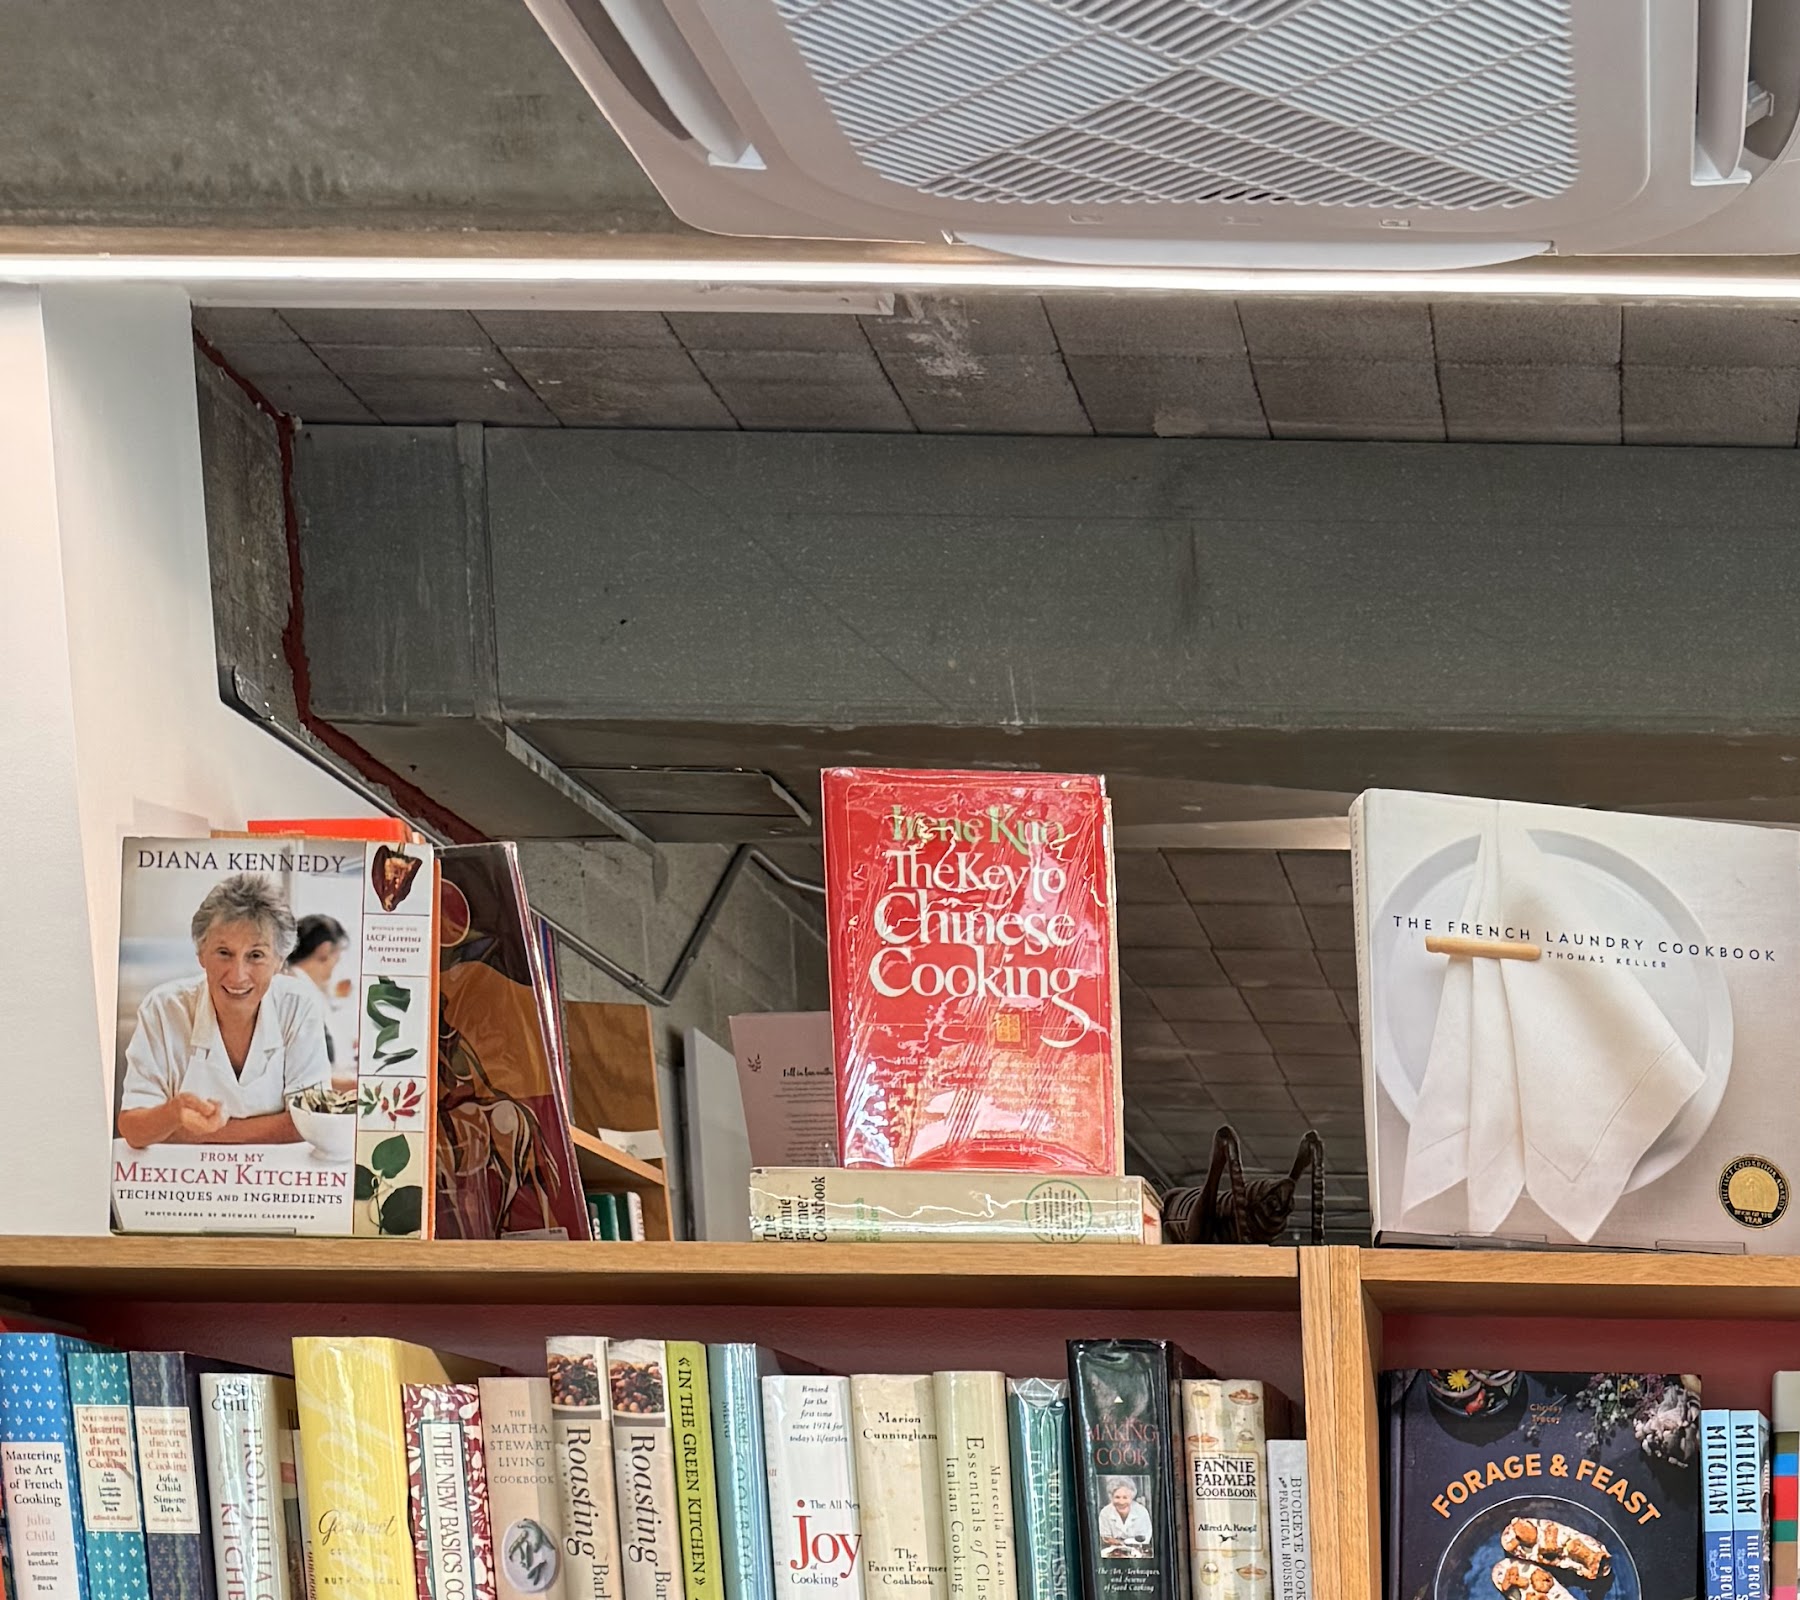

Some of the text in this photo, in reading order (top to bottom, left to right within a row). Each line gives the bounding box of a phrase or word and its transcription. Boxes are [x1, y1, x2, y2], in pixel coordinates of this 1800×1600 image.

[889, 804, 986, 844] Irene
[138, 850, 347, 874] DIANA KENNEDY
[886, 849, 1067, 910] The Key to
[873, 891, 1077, 956] Chinese
[1392, 914, 1777, 963] THE FRENCH LAUNDRY COOKBOOK
[1546, 950, 1668, 970] THOMAS KELLER
[868, 946, 1090, 1049] Cooking
[114, 1161, 349, 1188] MEXICAN KITCHEN
[116, 1188, 214, 1202] TECHNIQUES
[244, 1192, 344, 1205] INGREDIENTS
[432, 1432, 455, 1468] THE
[434, 1472, 457, 1513] NEW
[1431, 1452, 1662, 1526] FORAGE & FEAST
[439, 1515, 463, 1574] BASICS
[791, 1513, 862, 1580] Joy
[791, 1572, 839, 1588] Cooking
